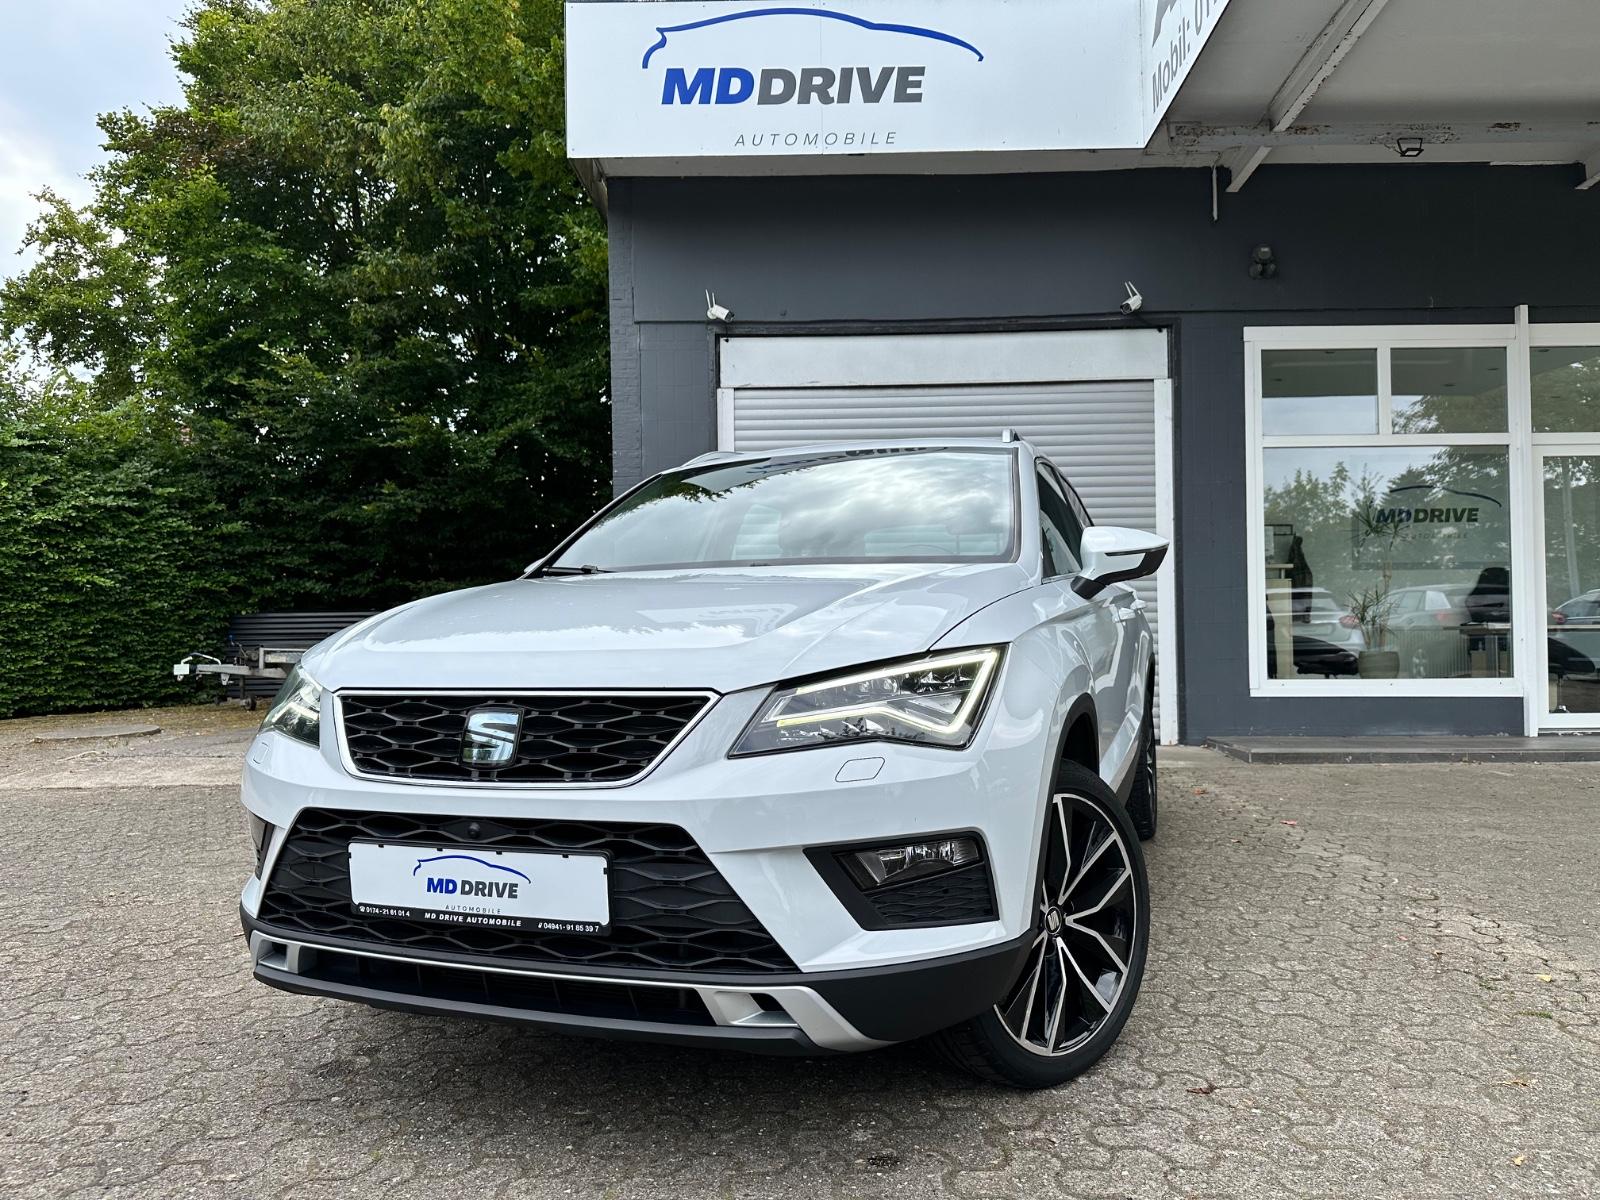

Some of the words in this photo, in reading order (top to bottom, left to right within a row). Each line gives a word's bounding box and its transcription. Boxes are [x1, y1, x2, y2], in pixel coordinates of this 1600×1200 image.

[1152, 17, 1190, 114] Mobil:
[735, 132, 897, 147] AUTOMOBILE
[427, 877, 458, 894] MD
[460, 879, 519, 899] DRIVE
[445, 904, 502, 914] AUTOMOBILE
[424, 912, 437, 920] MD
[439, 913, 464, 922] DRIVE
[466, 916, 522, 927] AUTOMOBILE
